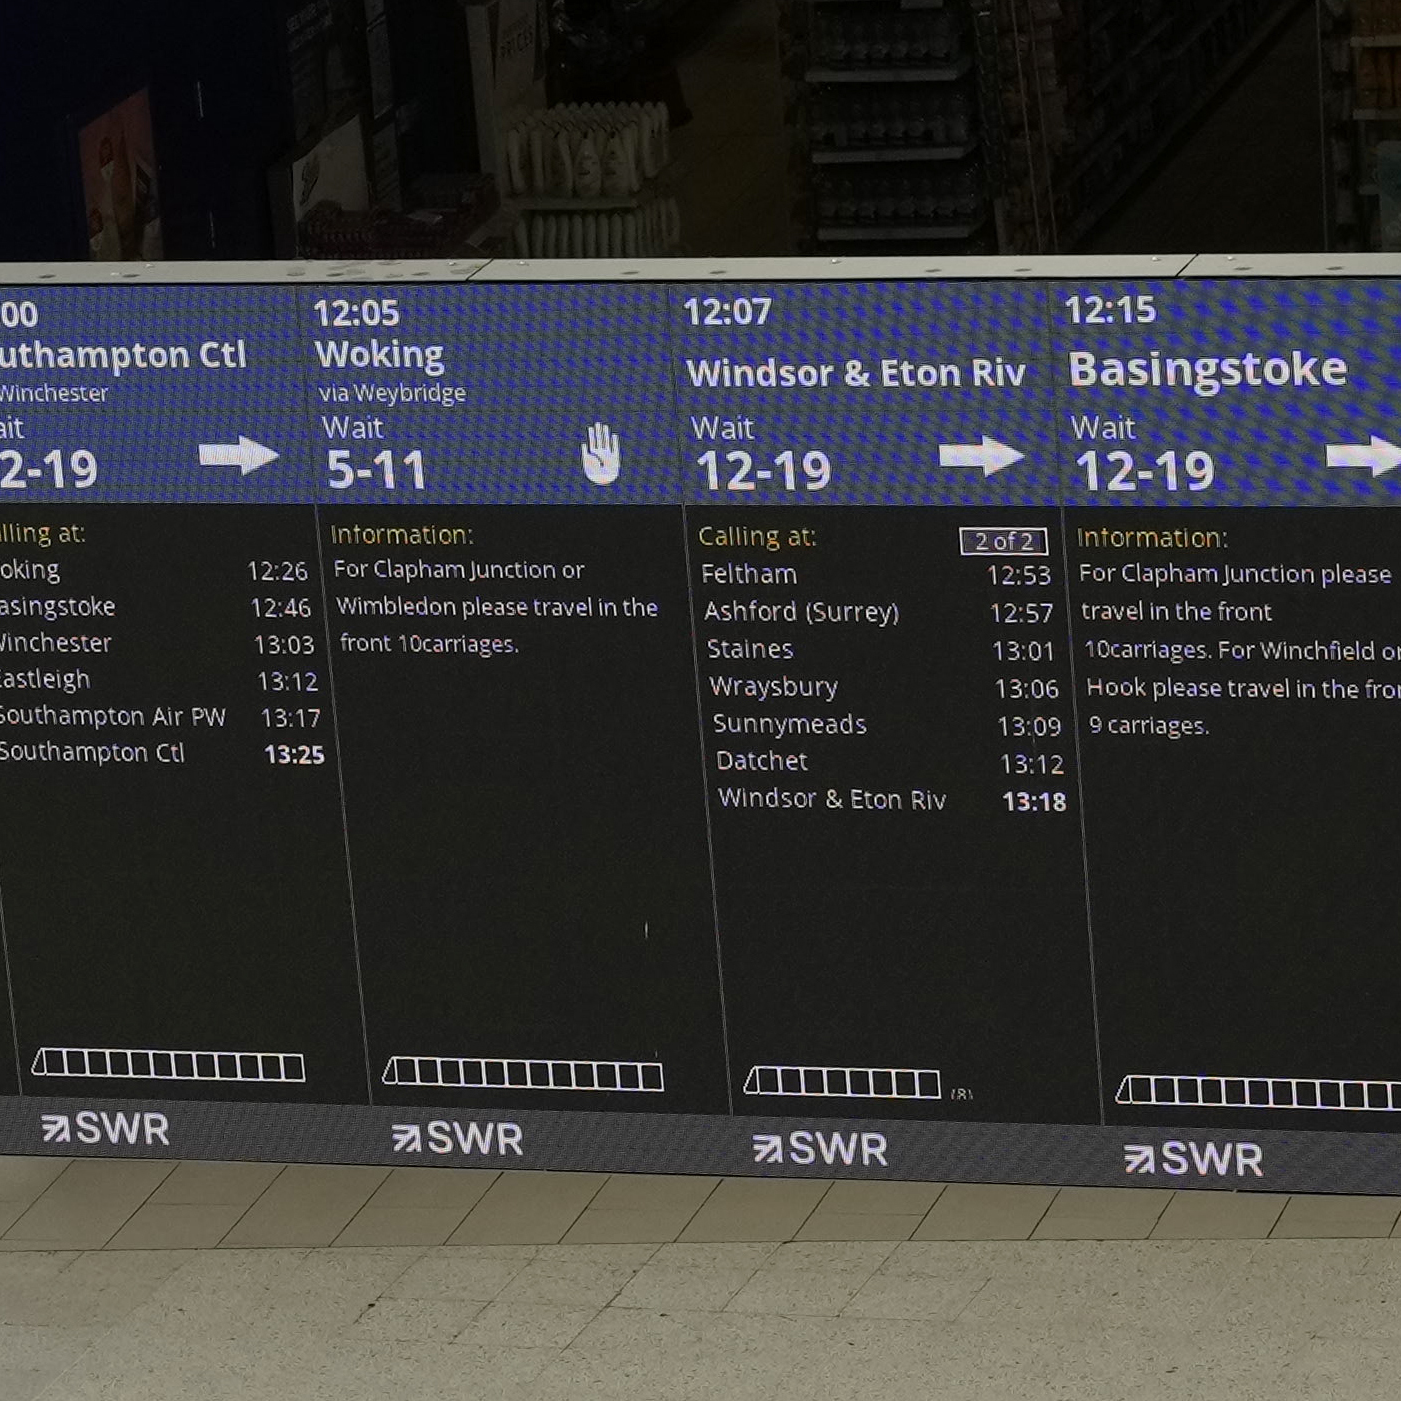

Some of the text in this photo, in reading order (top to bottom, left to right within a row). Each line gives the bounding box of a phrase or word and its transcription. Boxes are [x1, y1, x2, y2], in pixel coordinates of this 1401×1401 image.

[314, 299, 400, 327] 12:05
[683, 297, 772, 326] 12:07
[1065, 295, 1157, 324] 12:15
[199, 339, 247, 368] Ctl
[314, 338, 445, 377] Woking
[685, 357, 1026, 387] Windsor & Eton Riv
[1069, 350, 1348, 397] Basingstoke
[316, 381, 467, 407] via Weybridge
[321, 415, 384, 439] Wait
[690, 415, 755, 440] Wait
[1071, 415, 1136, 440] Wait
[328, 449, 425, 490] 5-11
[697, 450, 831, 491] 12-19
[1076, 450, 1215, 491] 12-19
[975, 531, 1034, 550] 2 of 2
[248, 560, 308, 582] 12:26
[1079, 562, 1392, 589] For Clapham Junction please
[251, 597, 312, 618] 12:46
[340, 632, 392, 652] front
[707, 638, 794, 660] Staines
[993, 640, 1053, 662] 13:01
[708, 675, 839, 703] Wraysbury
[996, 678, 1059, 699] 13:06
[151, 706, 184, 727] Air
[191, 707, 226, 727] PW
[261, 708, 321, 728] 13:17
[156, 741, 185, 763] Ctl
[264, 744, 325, 765] 13:25
[75, 1110, 170, 1146] SWR
[427, 1120, 524, 1156] SWR
[789, 1130, 888, 1166] SWR
[1162, 1141, 1263, 1177] SWR
